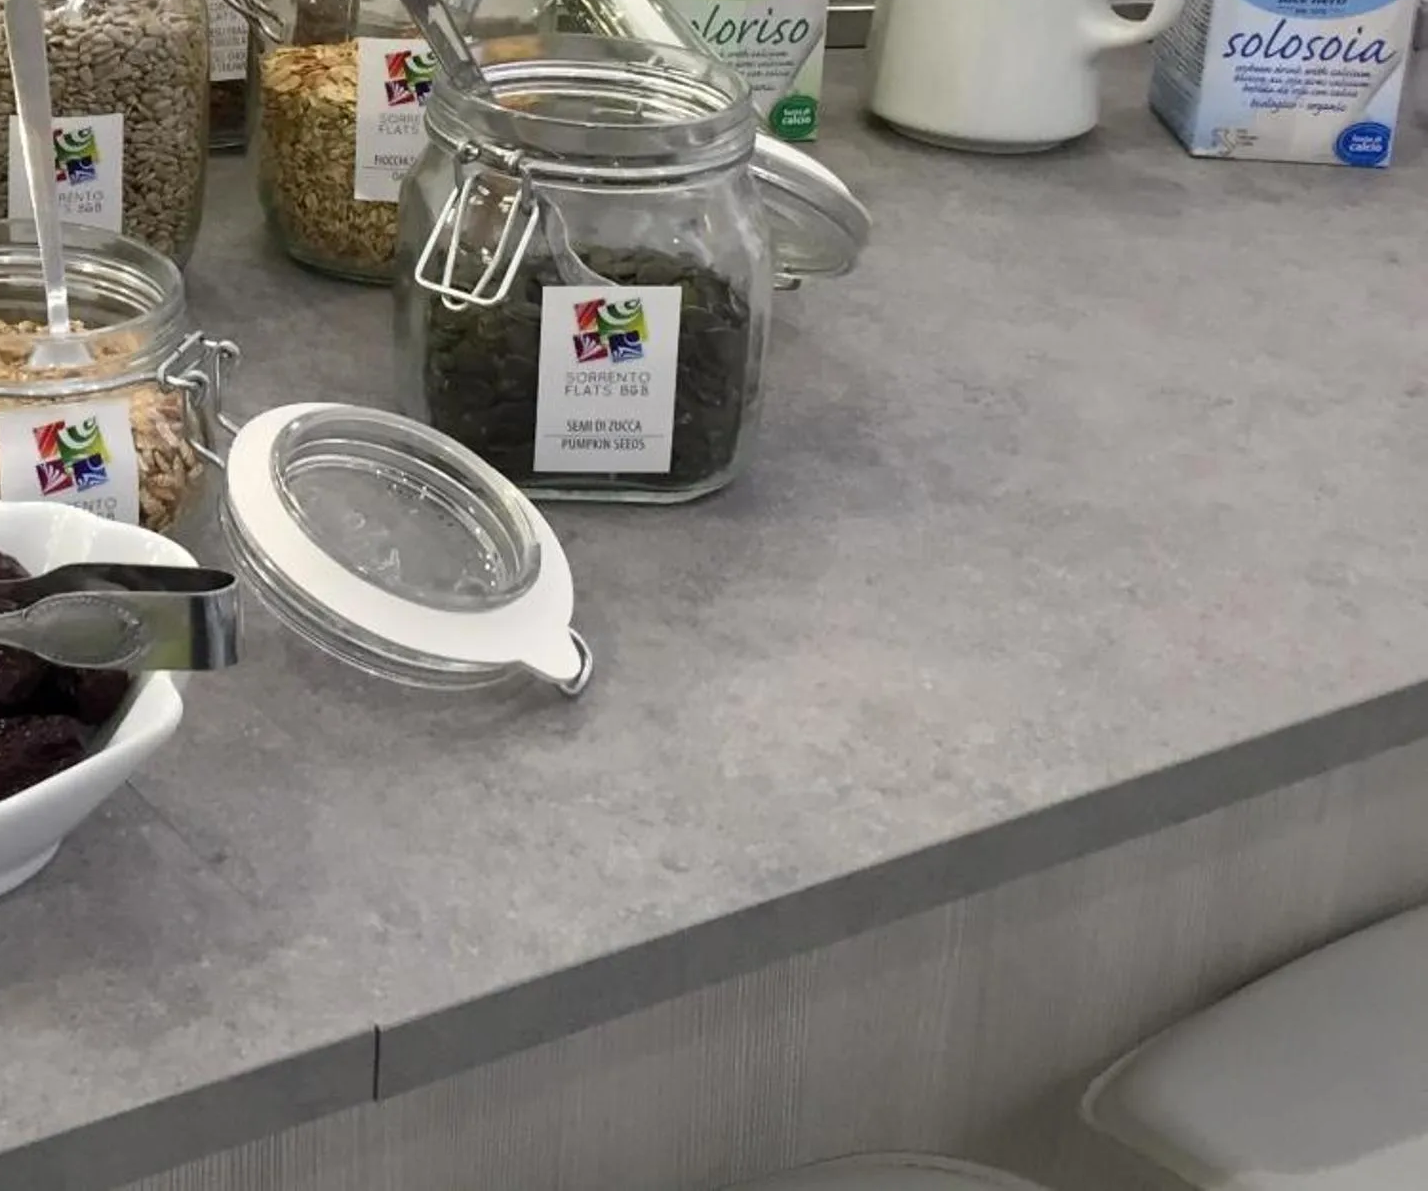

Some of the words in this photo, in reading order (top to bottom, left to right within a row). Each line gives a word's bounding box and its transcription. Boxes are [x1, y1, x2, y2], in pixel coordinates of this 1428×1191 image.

[692, 4, 809, 45] loriso
[1223, 19, 1398, 66] solosoia
[565, 371, 651, 384] SORRENTO
[564, 384, 612, 397] FLATS
[566, 420, 593, 433] SEMI
[595, 420, 606, 433] DI
[608, 420, 642, 433] ZUCCA
[561, 437, 611, 450] PUMPKIN
[614, 437, 646, 451] SEEDS
